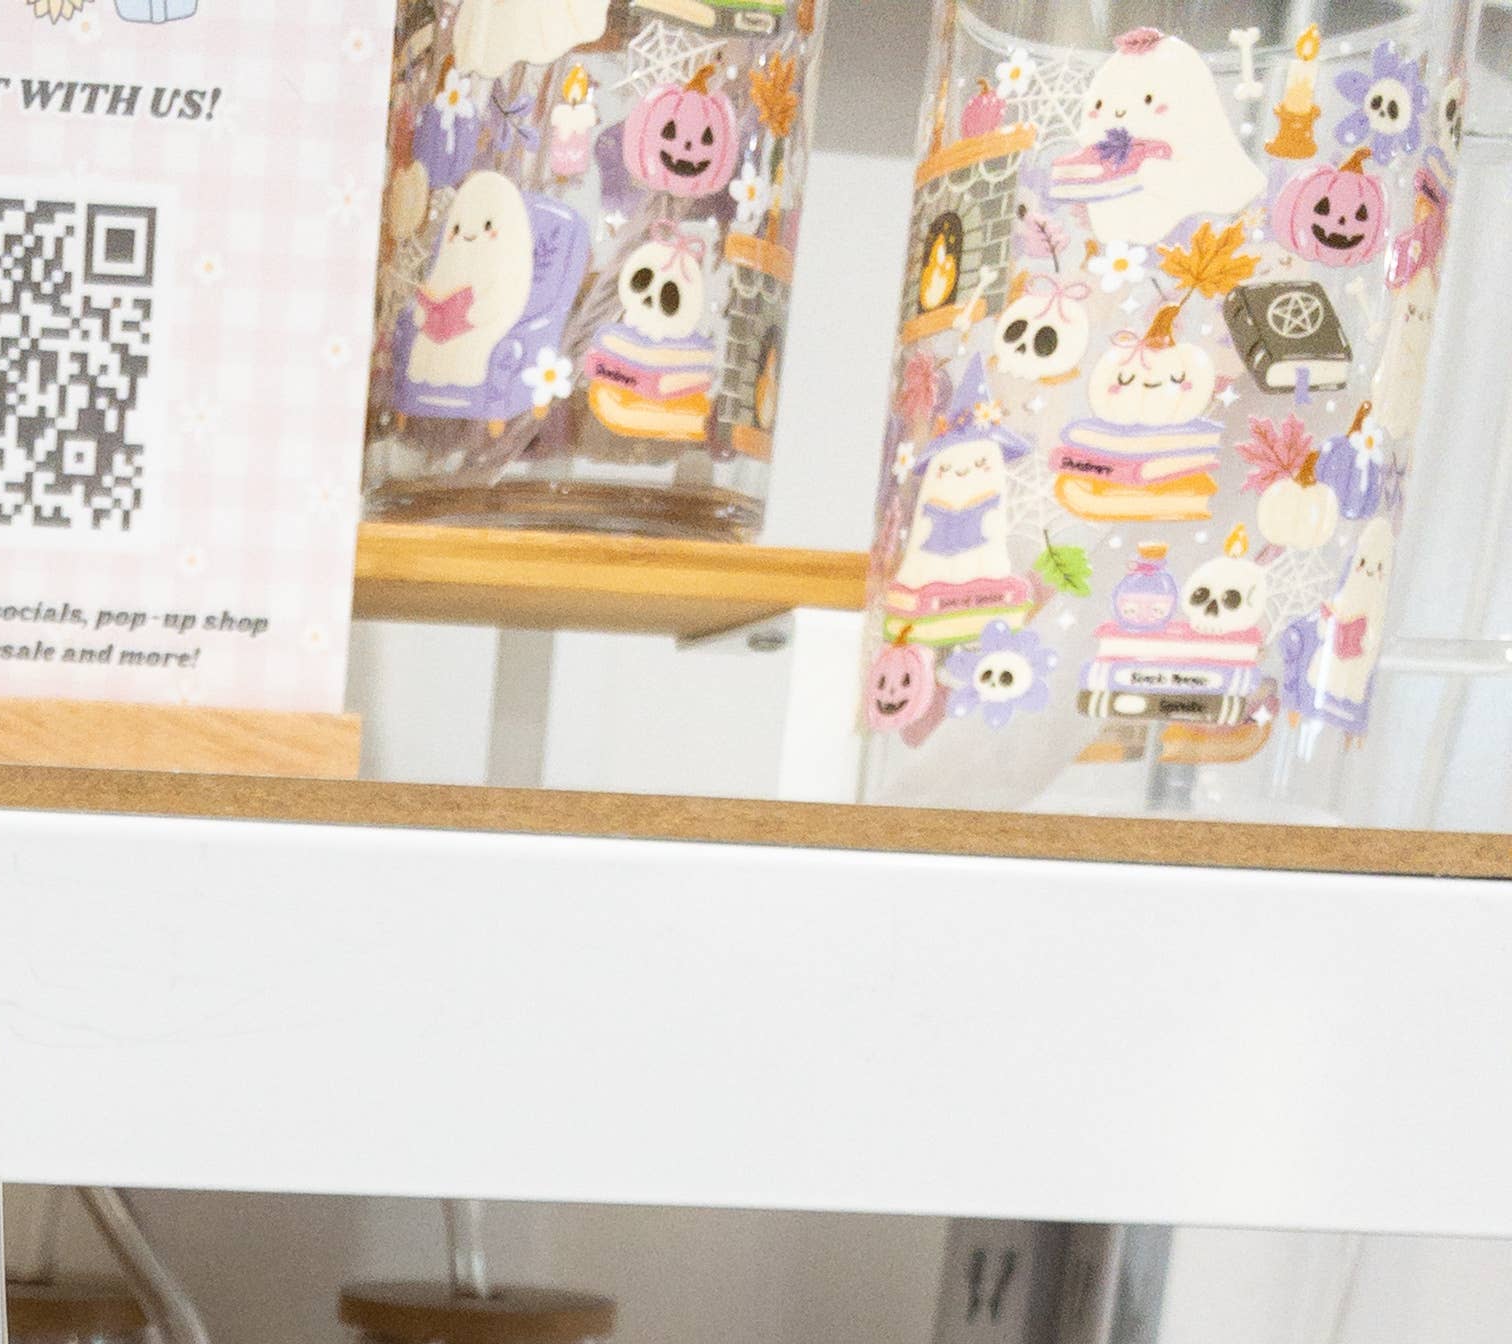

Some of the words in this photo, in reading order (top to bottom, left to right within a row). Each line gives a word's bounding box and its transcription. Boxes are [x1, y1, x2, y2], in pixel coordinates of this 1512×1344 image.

[20, 78, 143, 116] WITH
[149, 87, 222, 121] US!
[94, 607, 197, 635] pop-up
[201, 608, 270, 637] shop
[61, 643, 115, 666] and
[118, 647, 202, 669] more!
